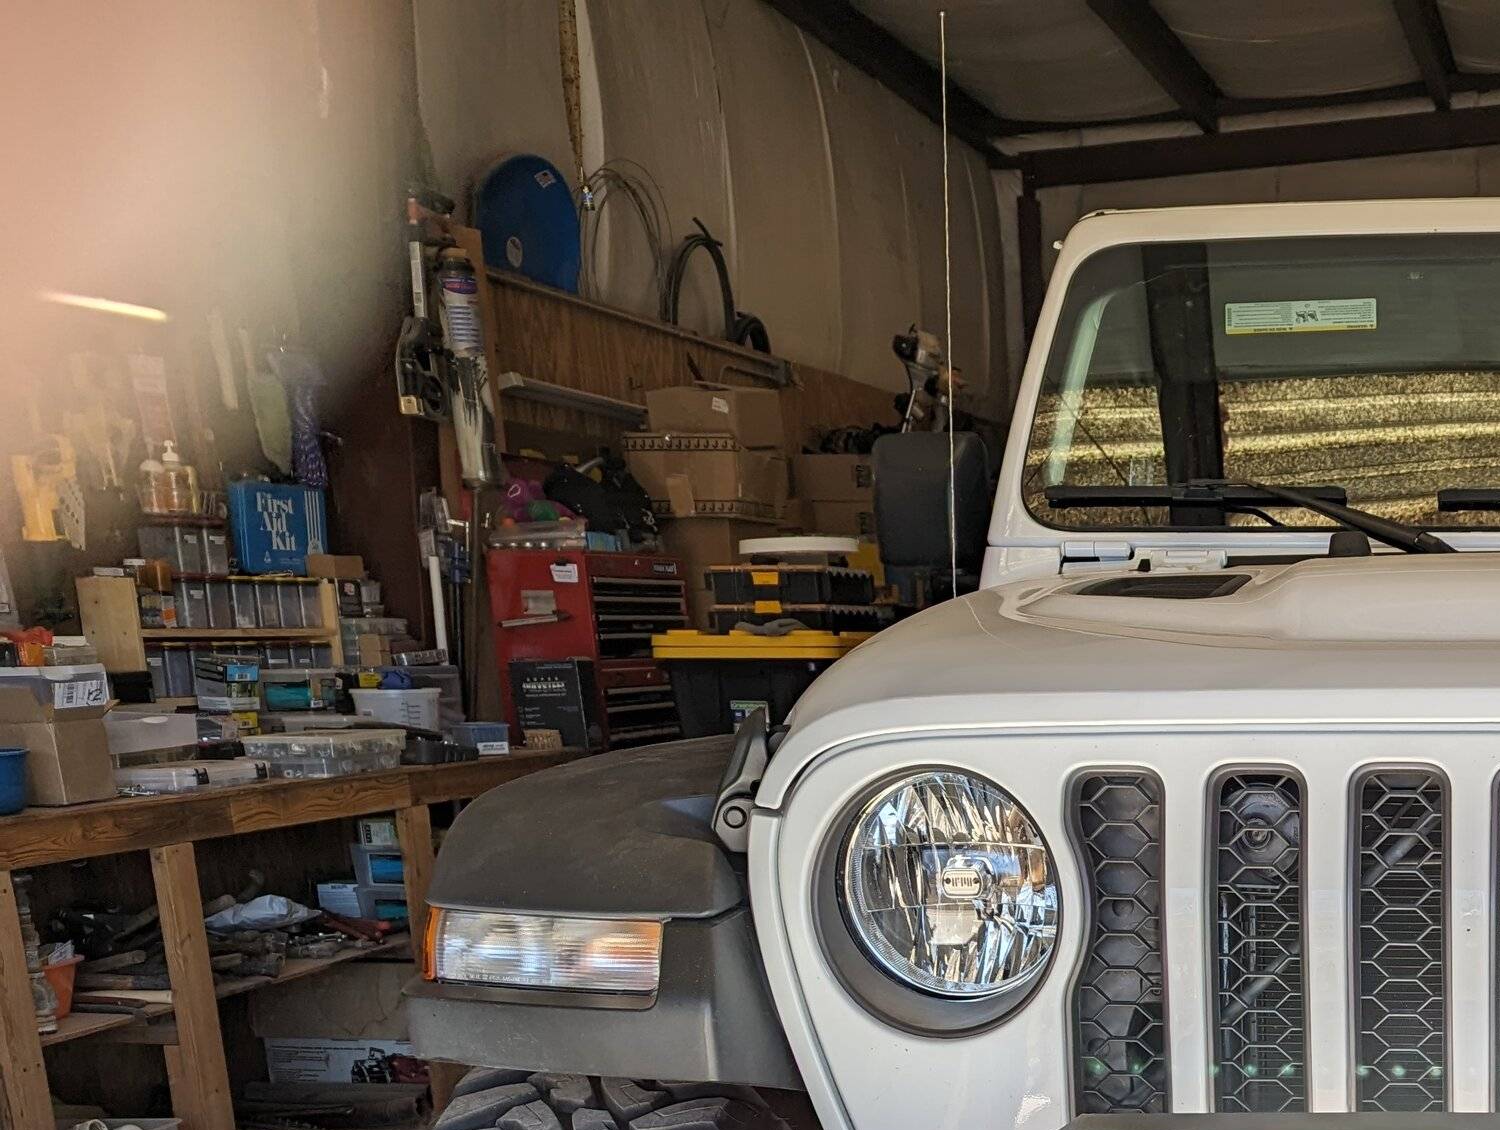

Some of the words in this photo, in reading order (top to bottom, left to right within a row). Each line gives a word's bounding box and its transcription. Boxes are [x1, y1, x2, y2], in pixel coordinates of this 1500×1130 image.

[256, 491, 294, 514] First
[260, 511, 288, 532] Aid
[271, 530, 296, 551] Kit
